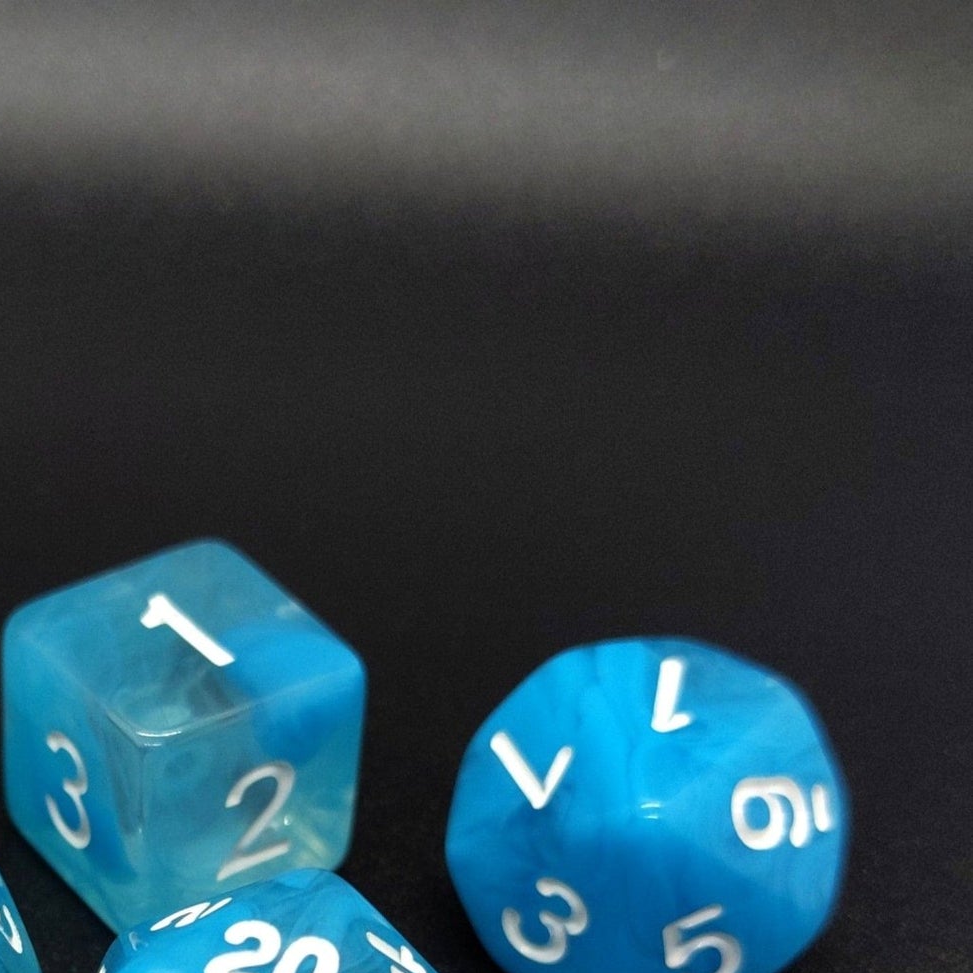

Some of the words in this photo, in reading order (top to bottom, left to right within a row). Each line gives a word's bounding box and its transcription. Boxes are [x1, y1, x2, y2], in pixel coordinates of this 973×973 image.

[139, 593, 236, 667] 1
[45, 731, 91, 850] 3
[216, 761, 296, 881] 2
[501, 876, 589, 965] 3
